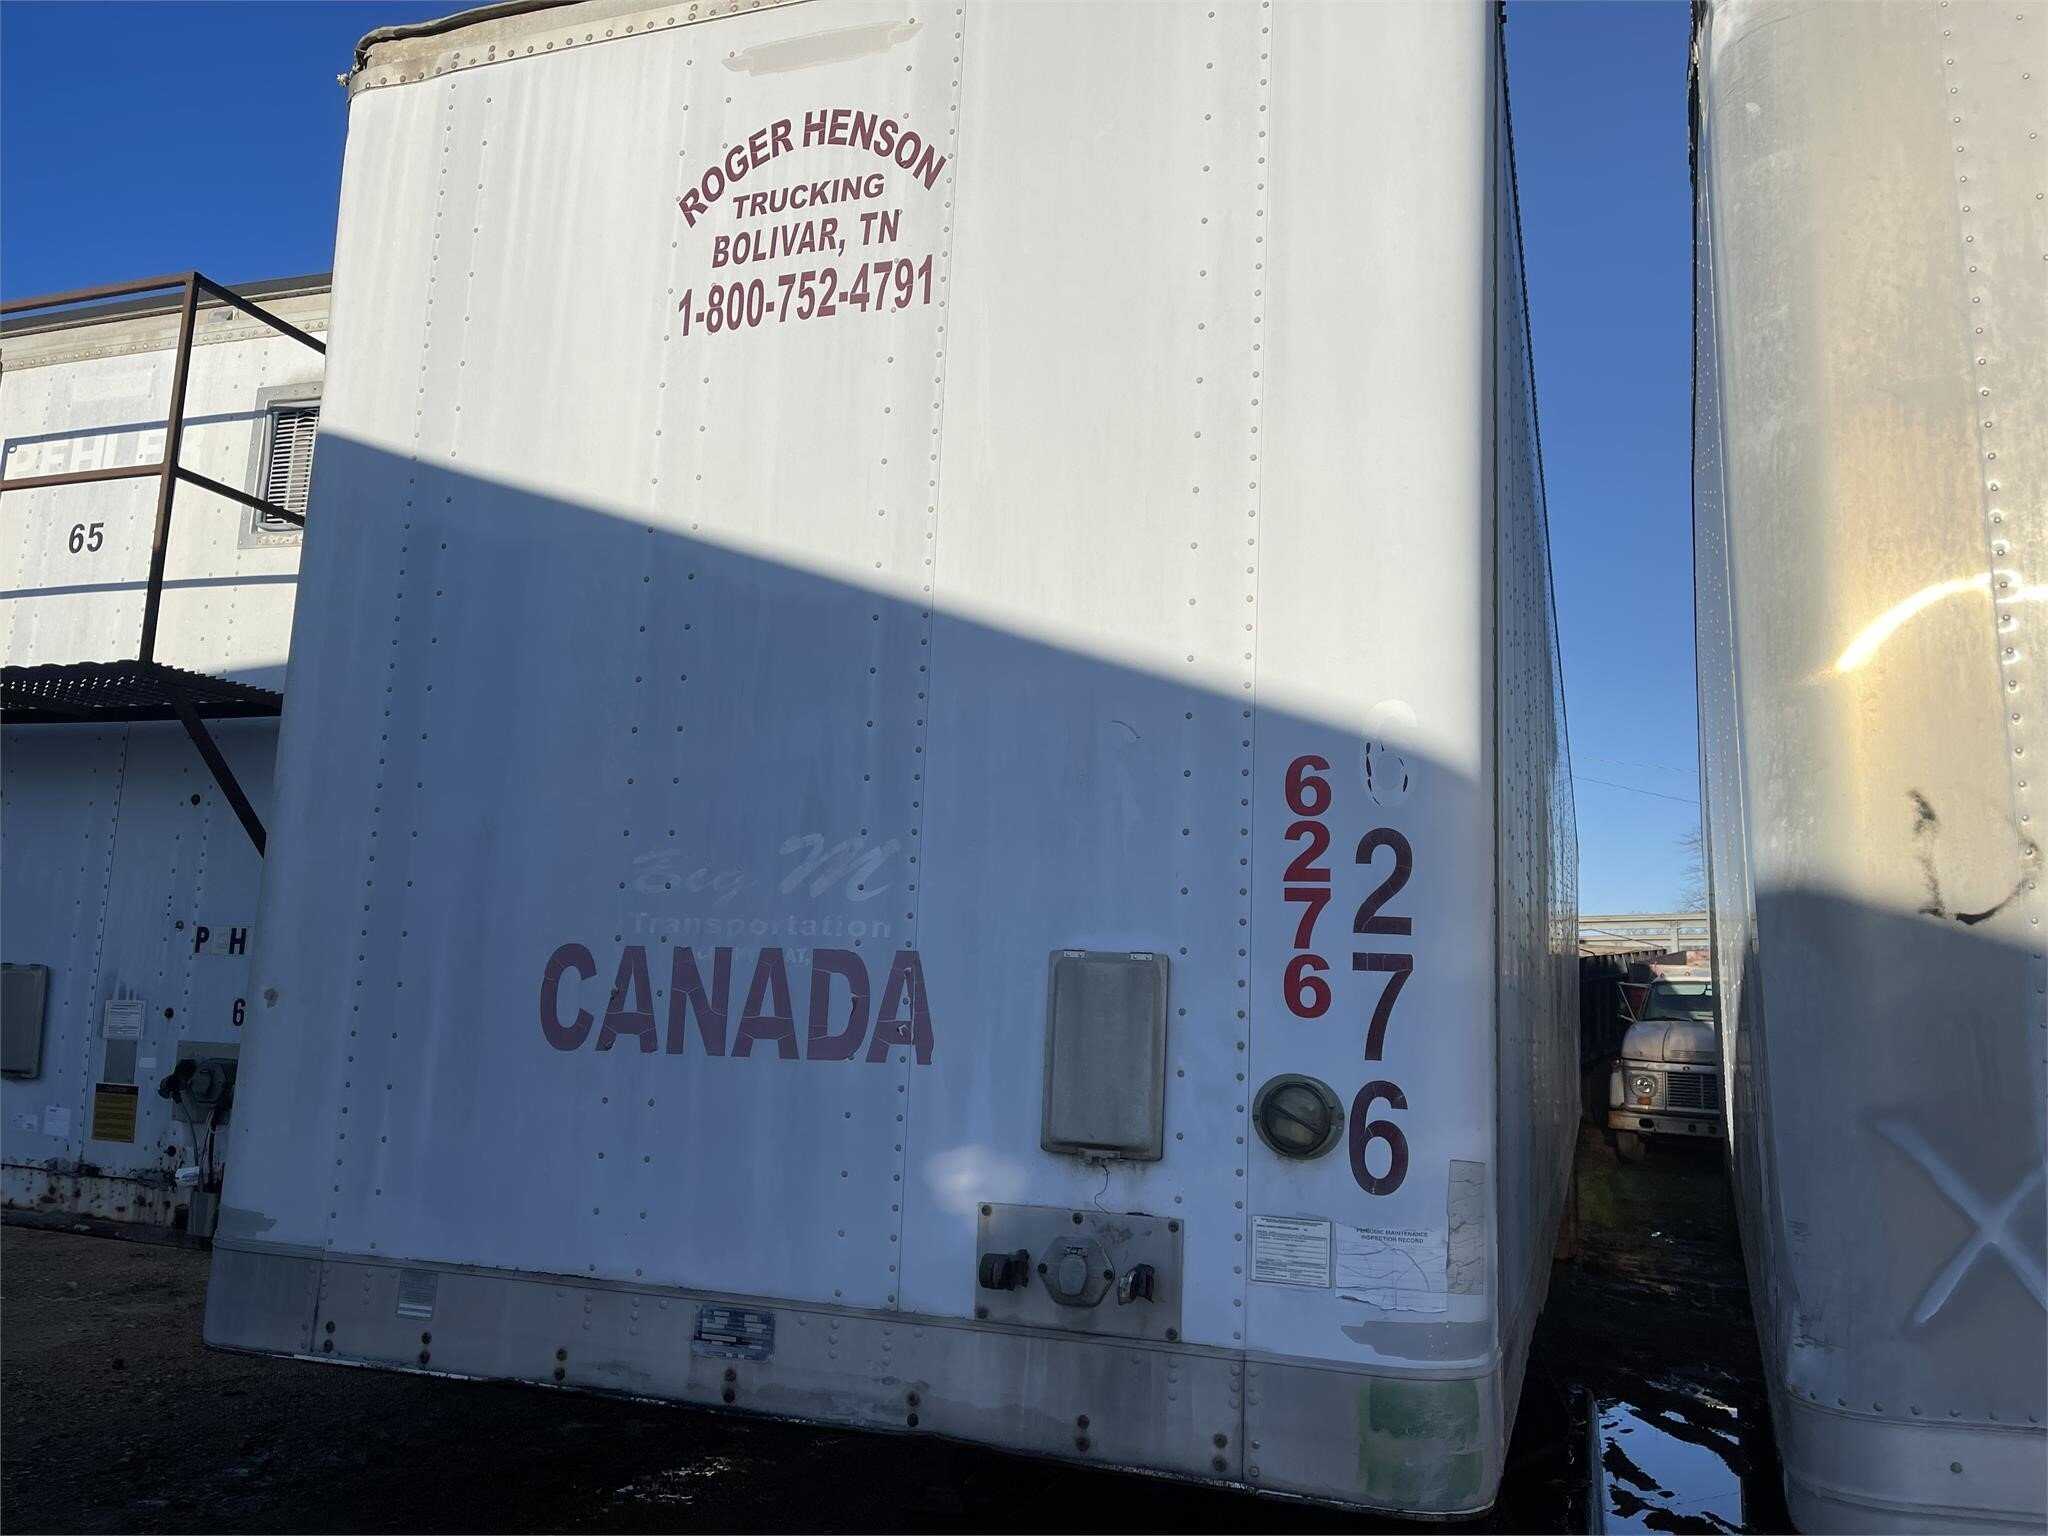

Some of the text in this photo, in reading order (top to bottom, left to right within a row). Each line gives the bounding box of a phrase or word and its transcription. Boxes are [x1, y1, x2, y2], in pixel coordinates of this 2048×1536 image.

[678, 108, 948, 229] ROGER HENSON
[733, 173, 885, 219] TRUCKING
[711, 209, 901, 268] BOLIVAR, TN
[678, 254, 933, 336] 1-800-752-4791
[68, 522, 105, 554] 65
[630, 911, 892, 940] Transportation
[540, 943, 935, 1065] CANADA
